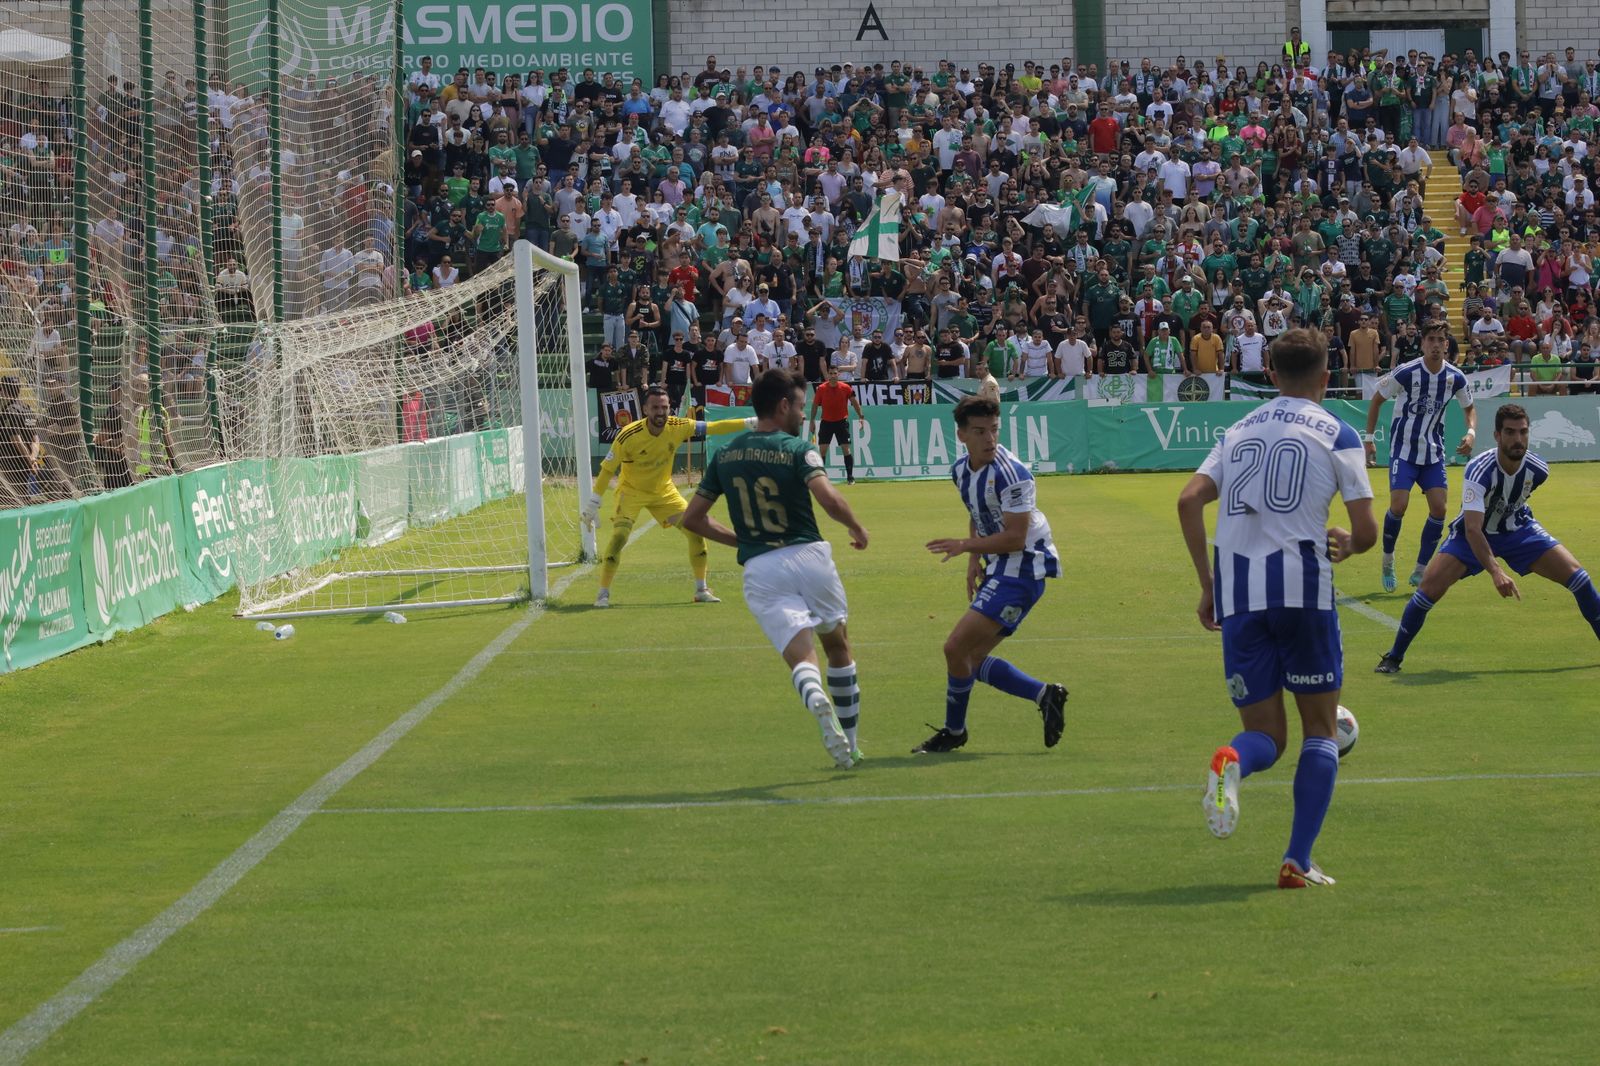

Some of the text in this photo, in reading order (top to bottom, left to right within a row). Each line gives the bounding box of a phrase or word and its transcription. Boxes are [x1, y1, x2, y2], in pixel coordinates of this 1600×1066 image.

[327, 4, 634, 45] MASMEDIO
[856, 3, 889, 41] A
[460, 52, 633, 68] MEDIOAMBIENTE
[1107, 351, 1126, 367] 23
[893, 404, 1050, 466] MAÍN
[1272, 408, 1338, 437] ROBLES
[1227, 438, 1308, 516] 20
[1392, 458, 1399, 475] 6
[732, 475, 788, 537] 16
